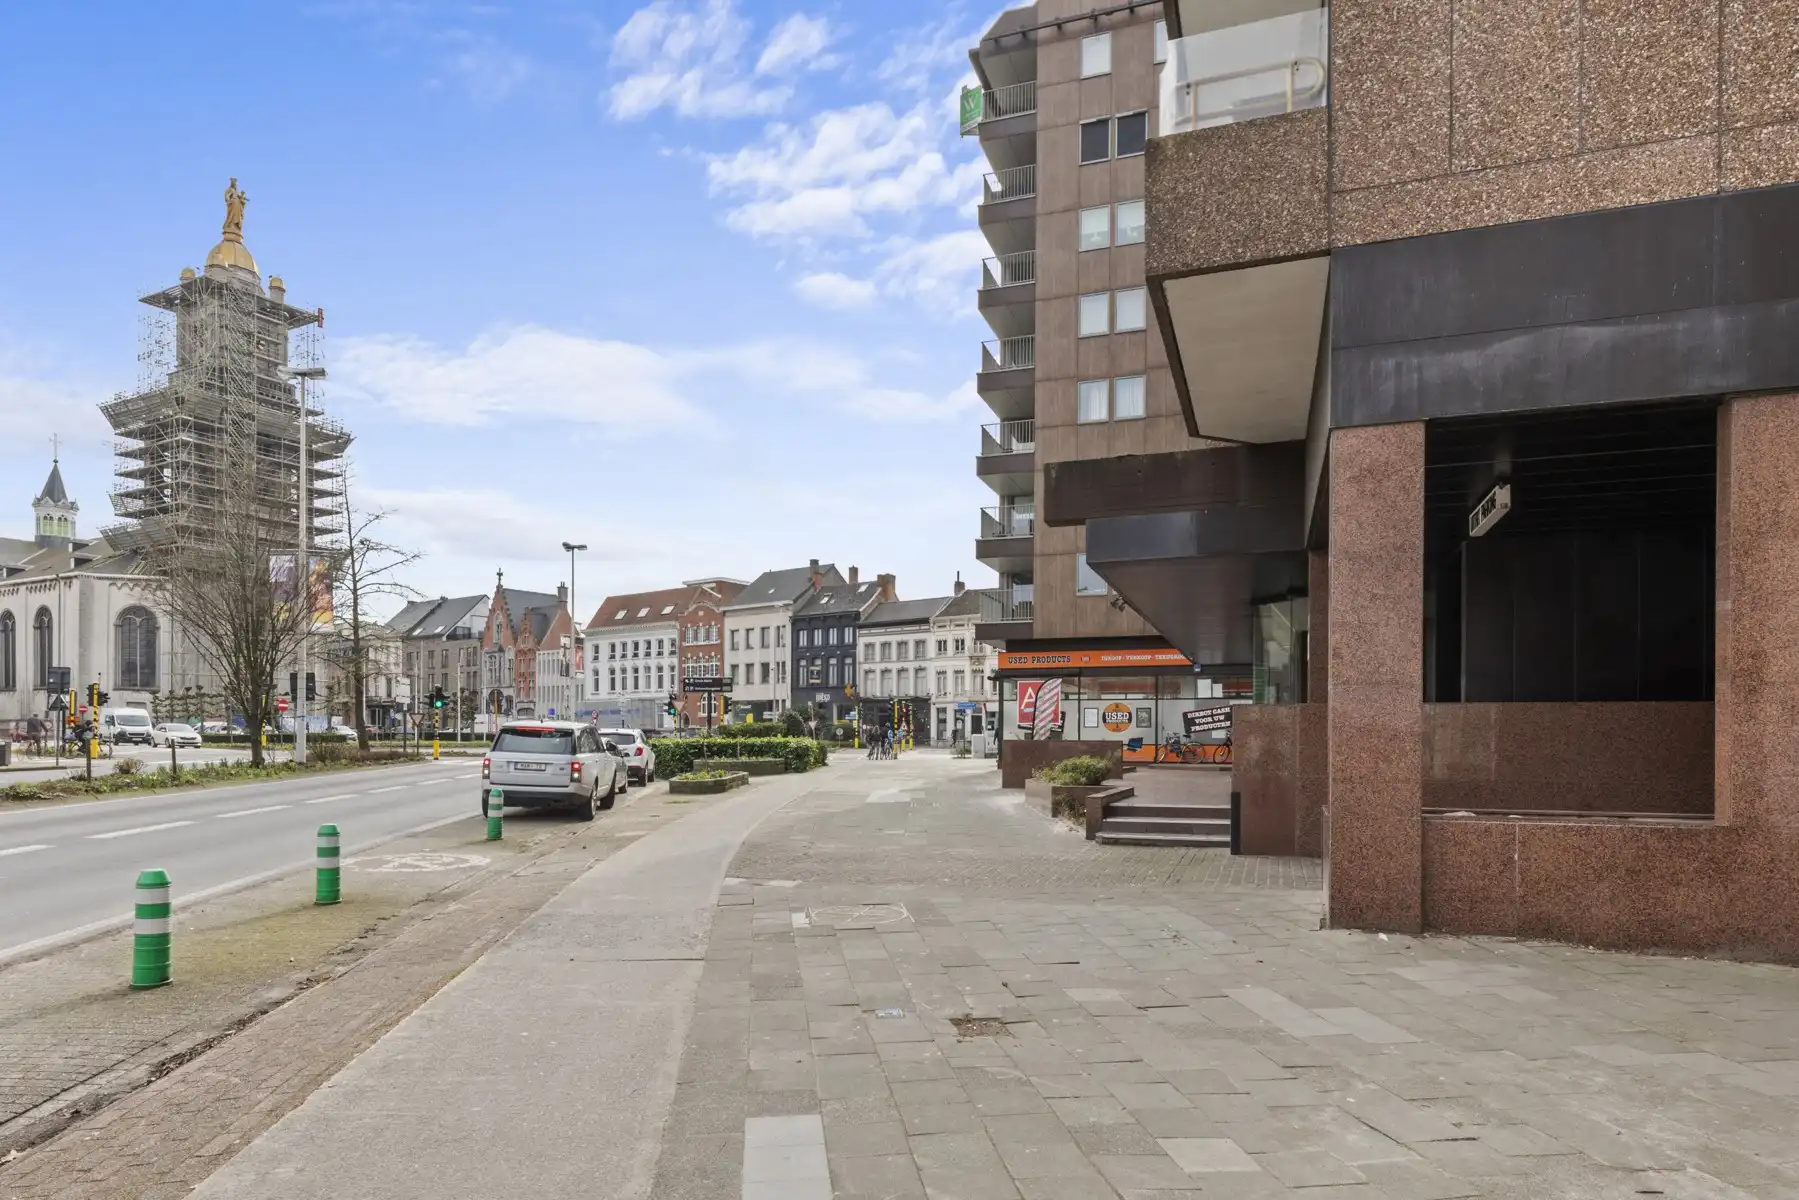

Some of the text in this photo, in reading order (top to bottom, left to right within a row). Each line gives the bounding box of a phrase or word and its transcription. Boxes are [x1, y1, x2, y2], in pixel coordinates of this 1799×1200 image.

[1008, 656, 1028, 664] USED
[1031, 655, 1071, 664] PRODUCTS
[1105, 712, 1129, 720] USED
[1187, 707, 1231, 719] DIRECT CASH
[1194, 716, 1213, 724] VOOR
[1190, 721, 1231, 732] PRODUCTEN
